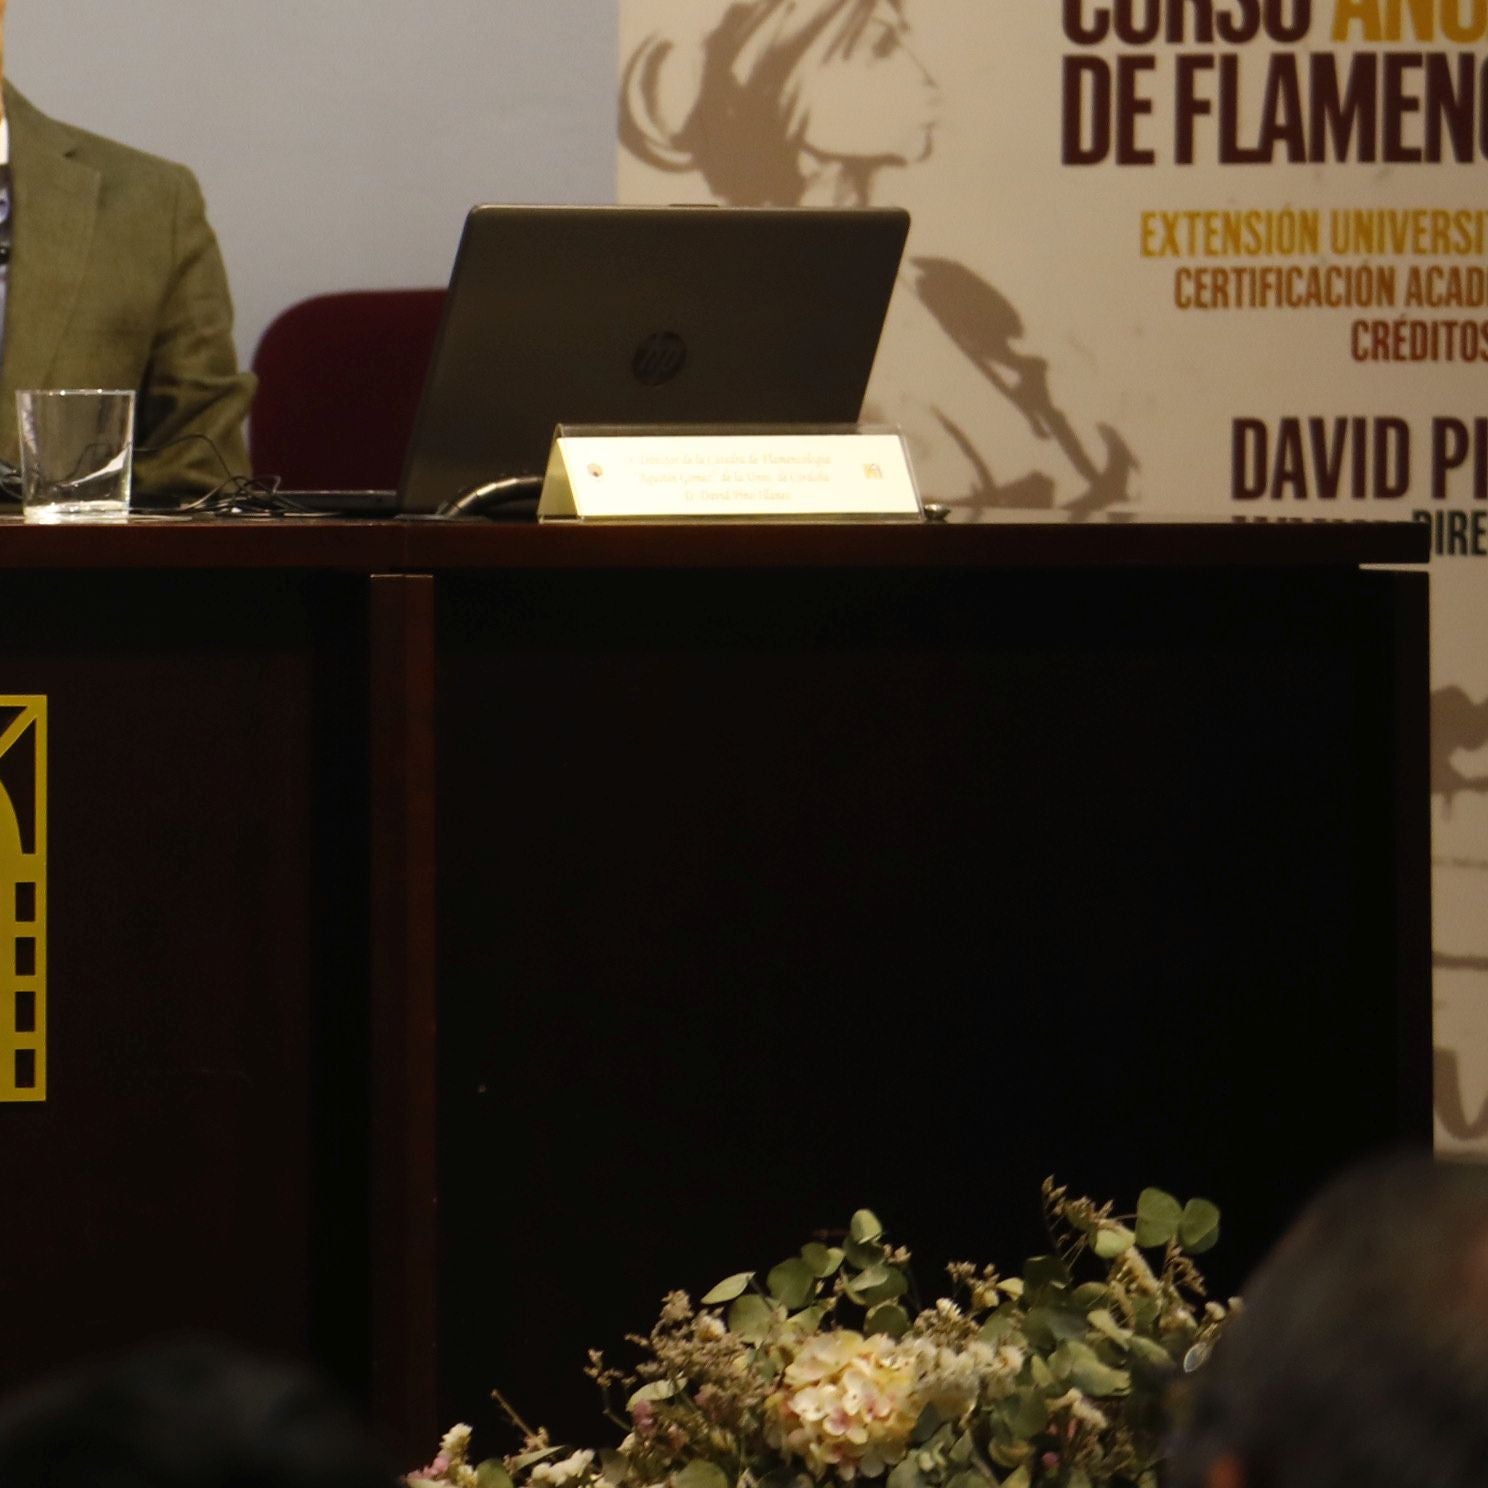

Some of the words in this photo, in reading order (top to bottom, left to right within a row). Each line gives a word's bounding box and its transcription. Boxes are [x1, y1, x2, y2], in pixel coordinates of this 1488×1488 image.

[1061, 53, 1156, 166] DE
[1173, 49, 1488, 165] FLAMEN
[1140, 203, 1320, 257] EXTENSIÓN
[1329, 208, 1488, 255] UNIVERSI
[1174, 259, 1396, 310] CERTIFICACIÓN
[1404, 264, 1488, 309] ACAD
[1231, 416, 1410, 500] DAVID
